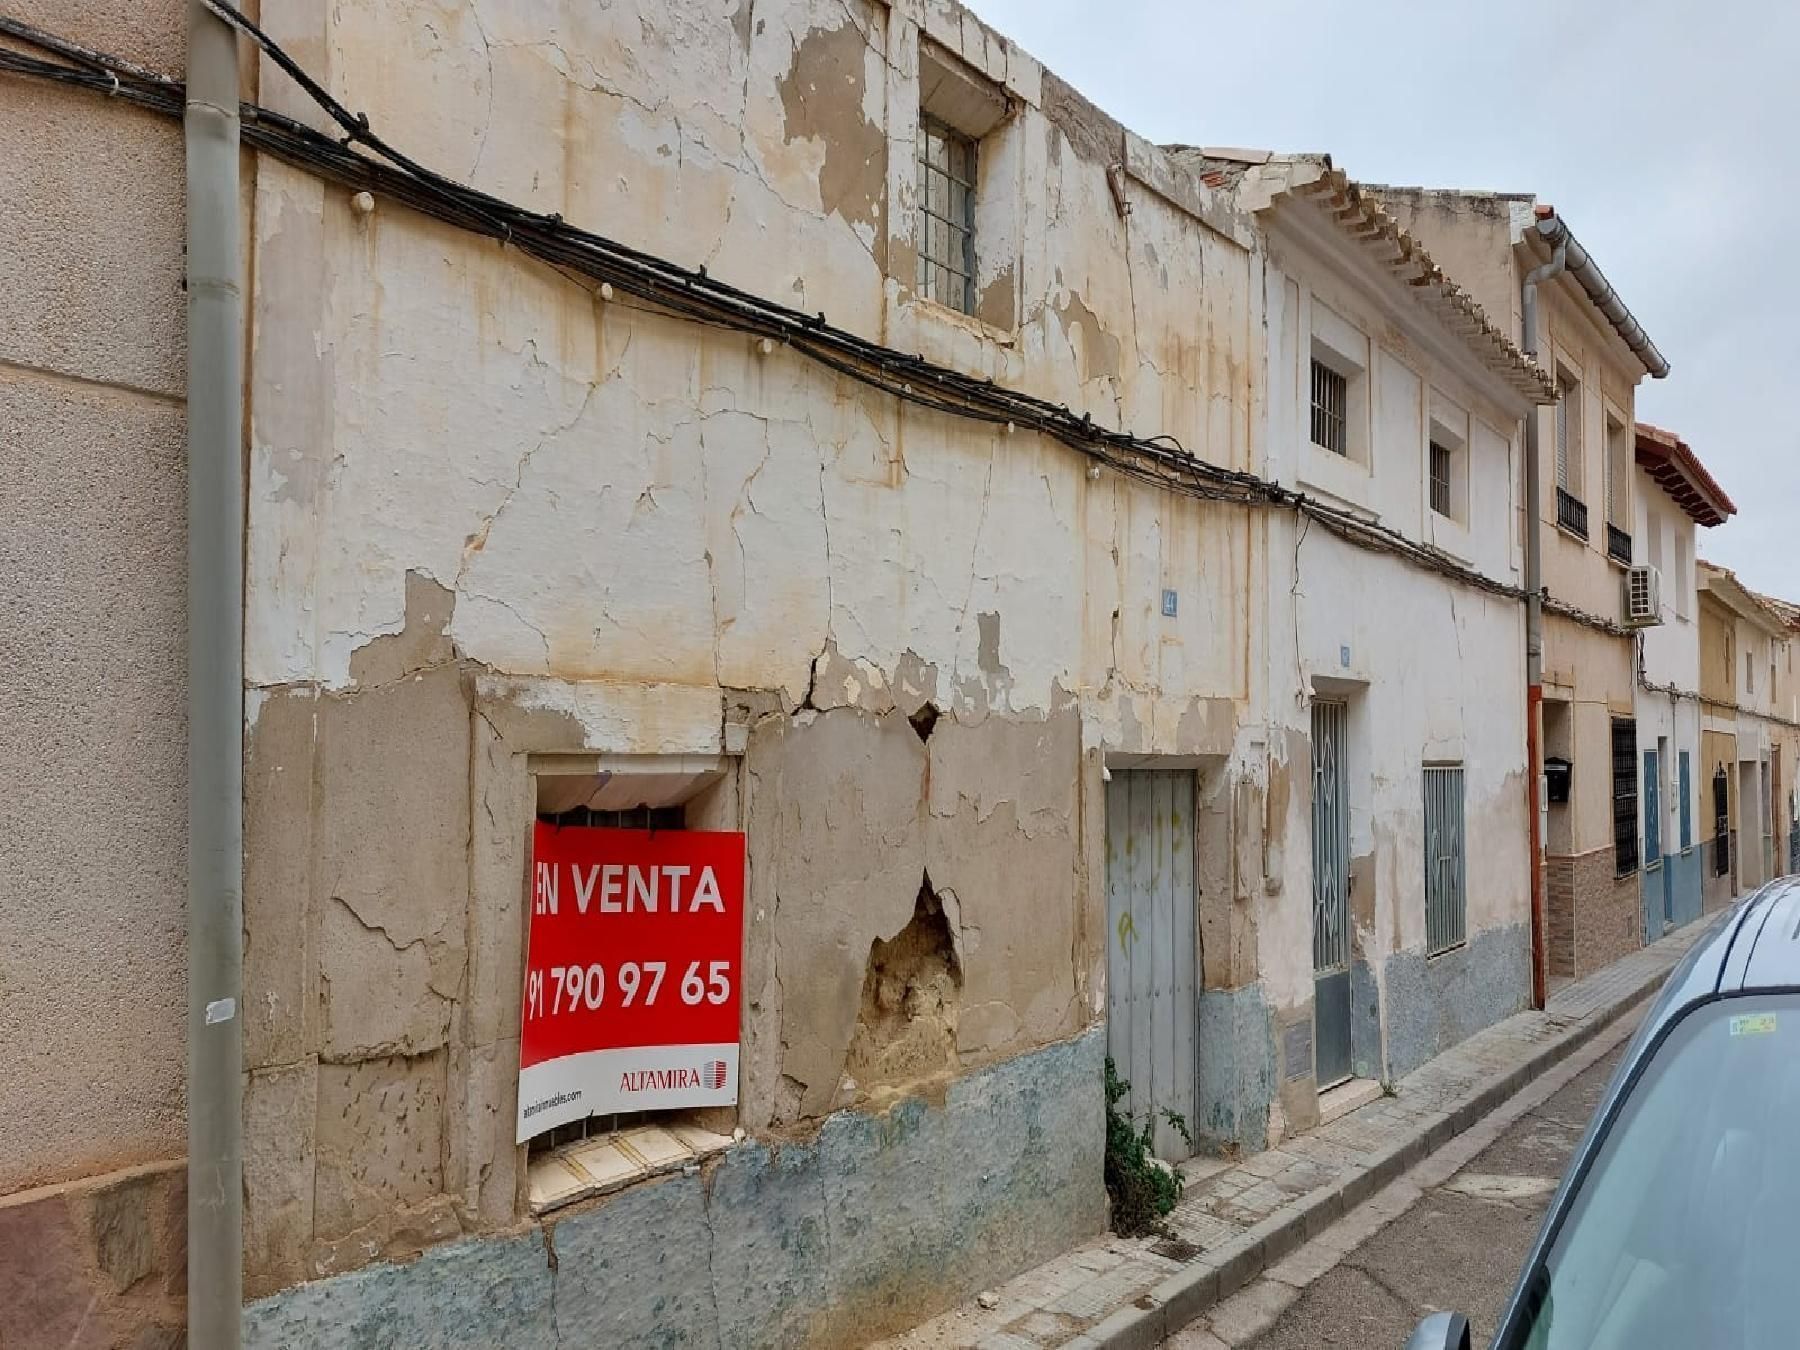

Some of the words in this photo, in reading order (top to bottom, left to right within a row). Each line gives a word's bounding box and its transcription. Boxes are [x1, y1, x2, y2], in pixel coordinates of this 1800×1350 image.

[536, 861, 559, 915] EN
[571, 864, 726, 914] VENTA
[529, 969, 543, 1020] 91
[551, 963, 605, 1015] 790
[618, 962, 667, 1008] 97
[680, 961, 730, 1005] 65
[620, 1067, 701, 1092] ALTAMIRA
